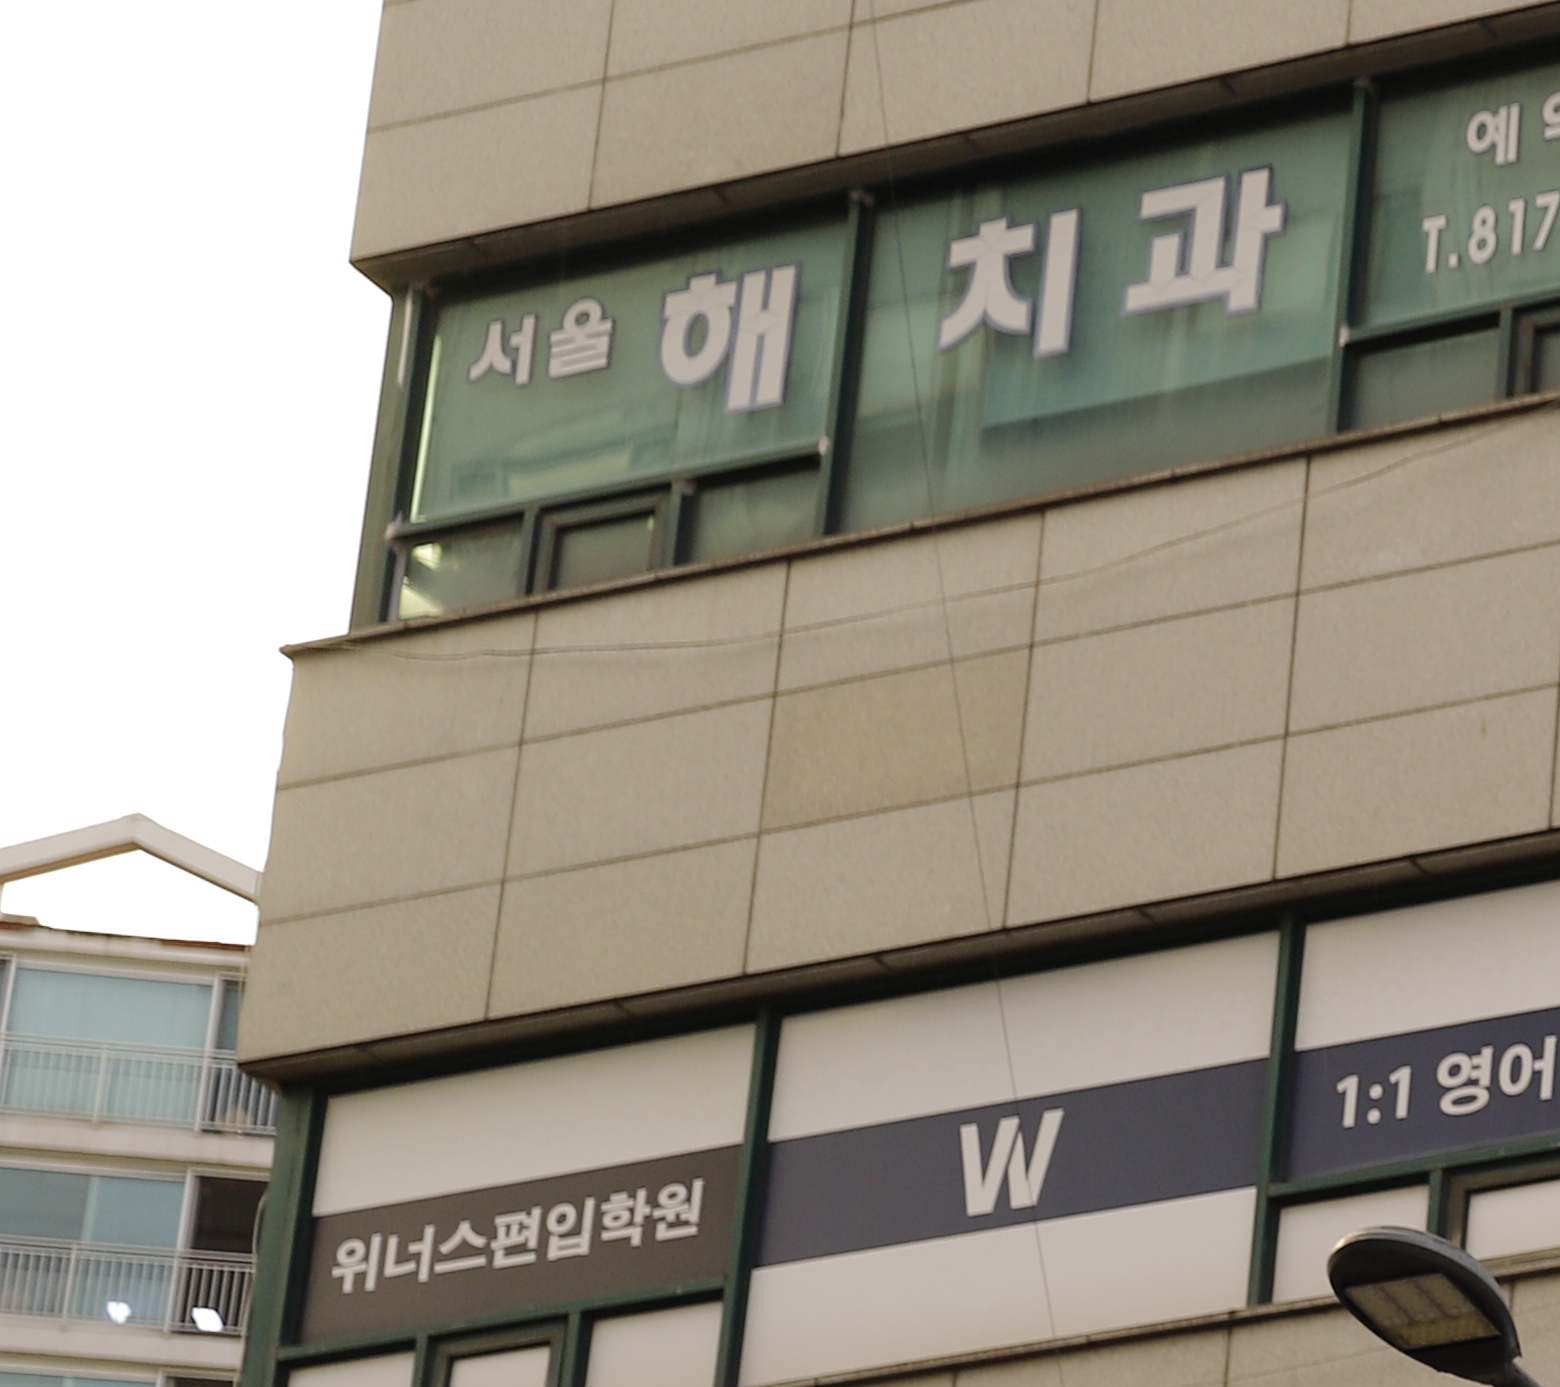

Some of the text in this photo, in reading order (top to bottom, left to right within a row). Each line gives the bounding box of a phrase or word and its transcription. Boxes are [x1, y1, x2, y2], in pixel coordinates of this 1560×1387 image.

[469, 297, 613, 386] 서울
[1334, 1065, 1413, 1129] 1:1
[959, 1107, 1064, 1217] W
[331, 1176, 706, 1294] 위너스편입학원
